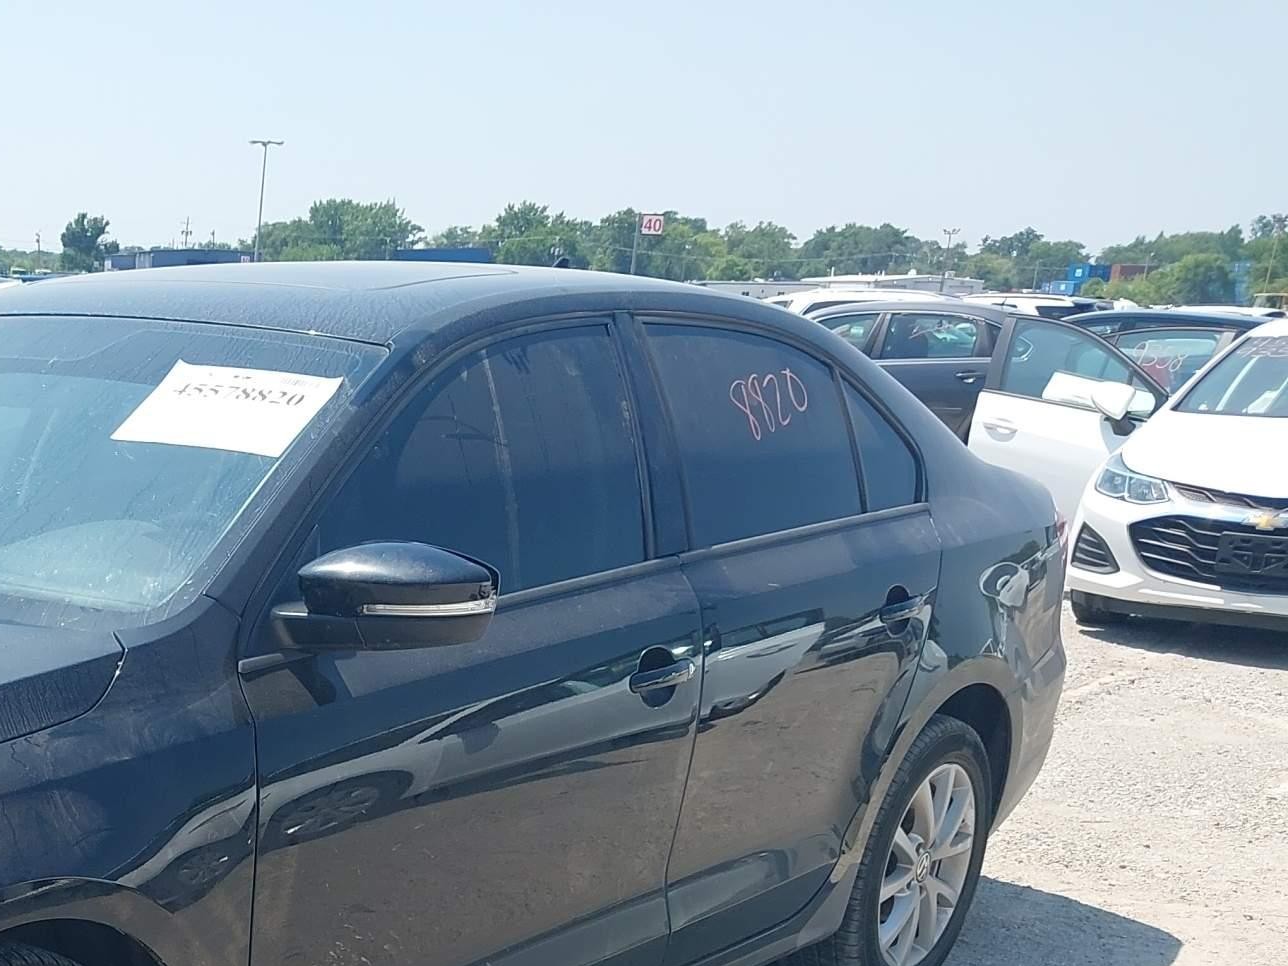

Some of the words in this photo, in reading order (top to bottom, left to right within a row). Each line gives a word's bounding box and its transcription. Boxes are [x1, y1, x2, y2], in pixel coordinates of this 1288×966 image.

[643, 218, 662, 233] 40
[172, 382, 306, 406] 45578820
[729, 367, 808, 441] 8820
